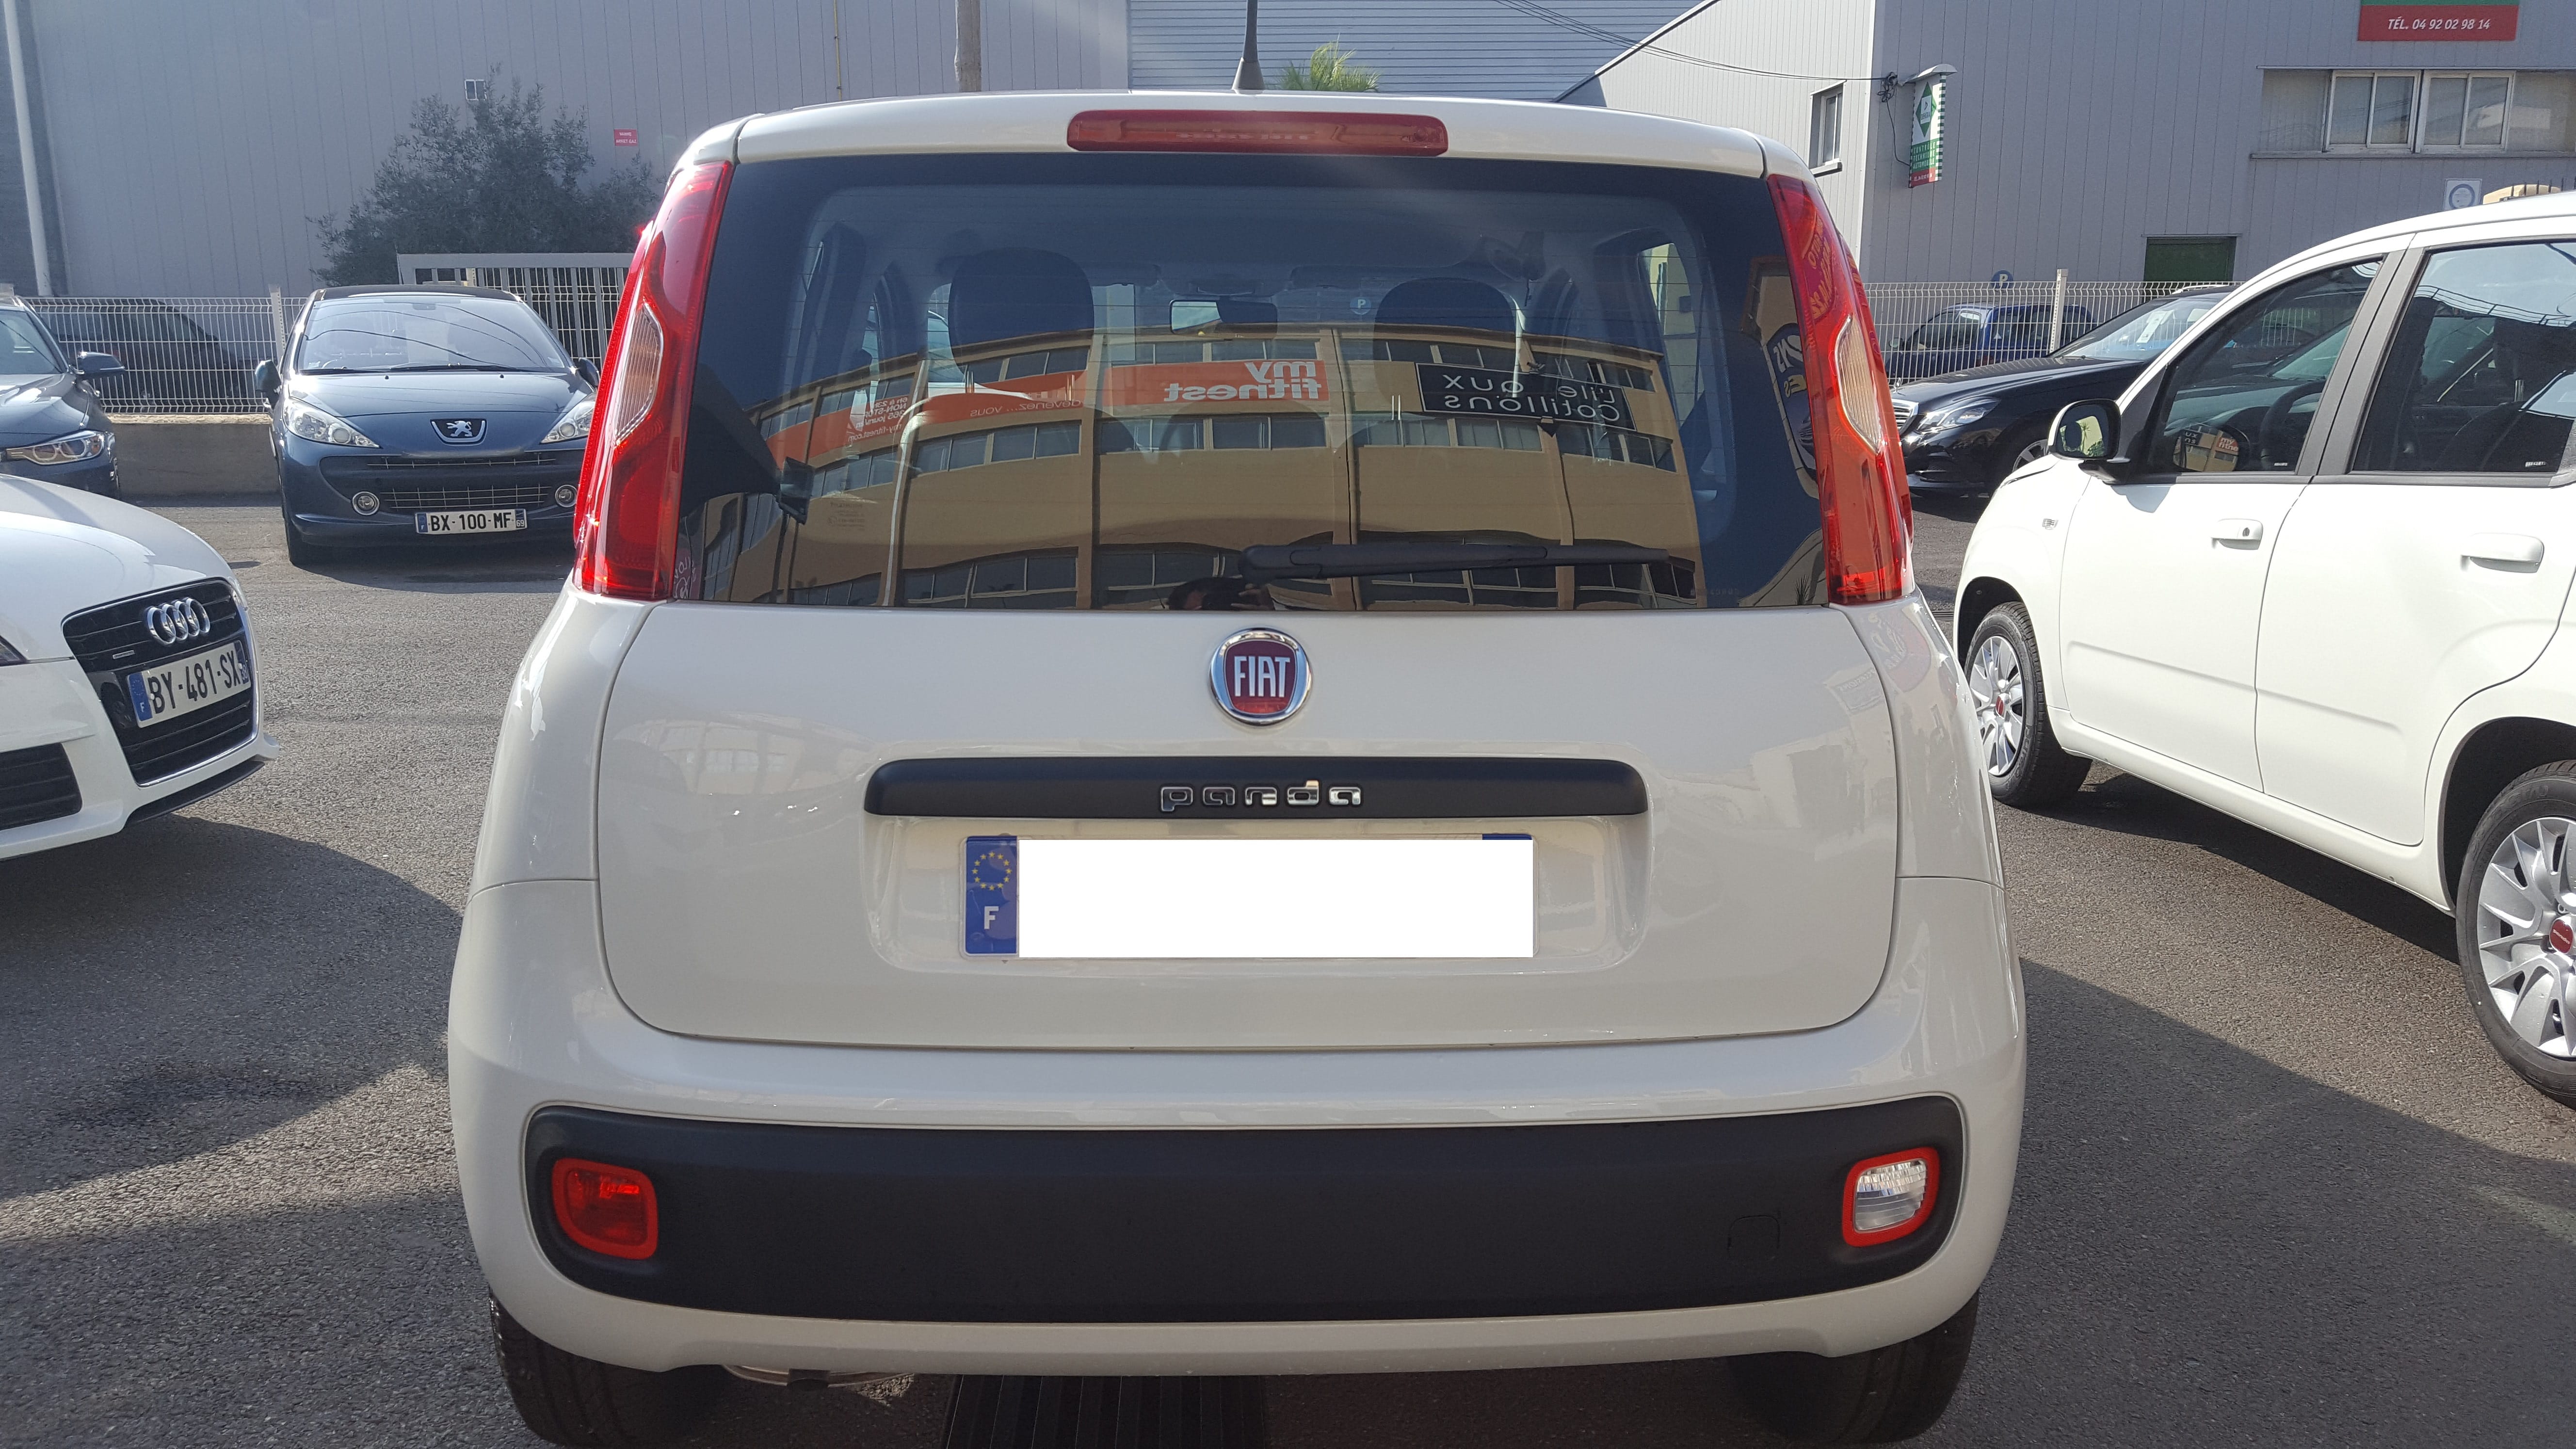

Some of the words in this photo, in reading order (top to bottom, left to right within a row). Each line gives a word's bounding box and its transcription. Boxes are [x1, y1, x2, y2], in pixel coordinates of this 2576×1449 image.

[2388, 16, 2408, 30] TÉL.
[2412, 19, 2426, 30] 04
[2429, 19, 2442, 30] 92
[2445, 19, 2458, 30] 02
[2461, 19, 2474, 30] 98
[2478, 19, 2491, 30] 14
[1999, 274, 2008, 287] P
[1358, 299, 1366, 309] P
[1234, 656, 1290, 697] FIAT
[140, 702, 145, 713] F
[1160, 779, 1361, 812] panda
[983, 905, 999, 930] F
